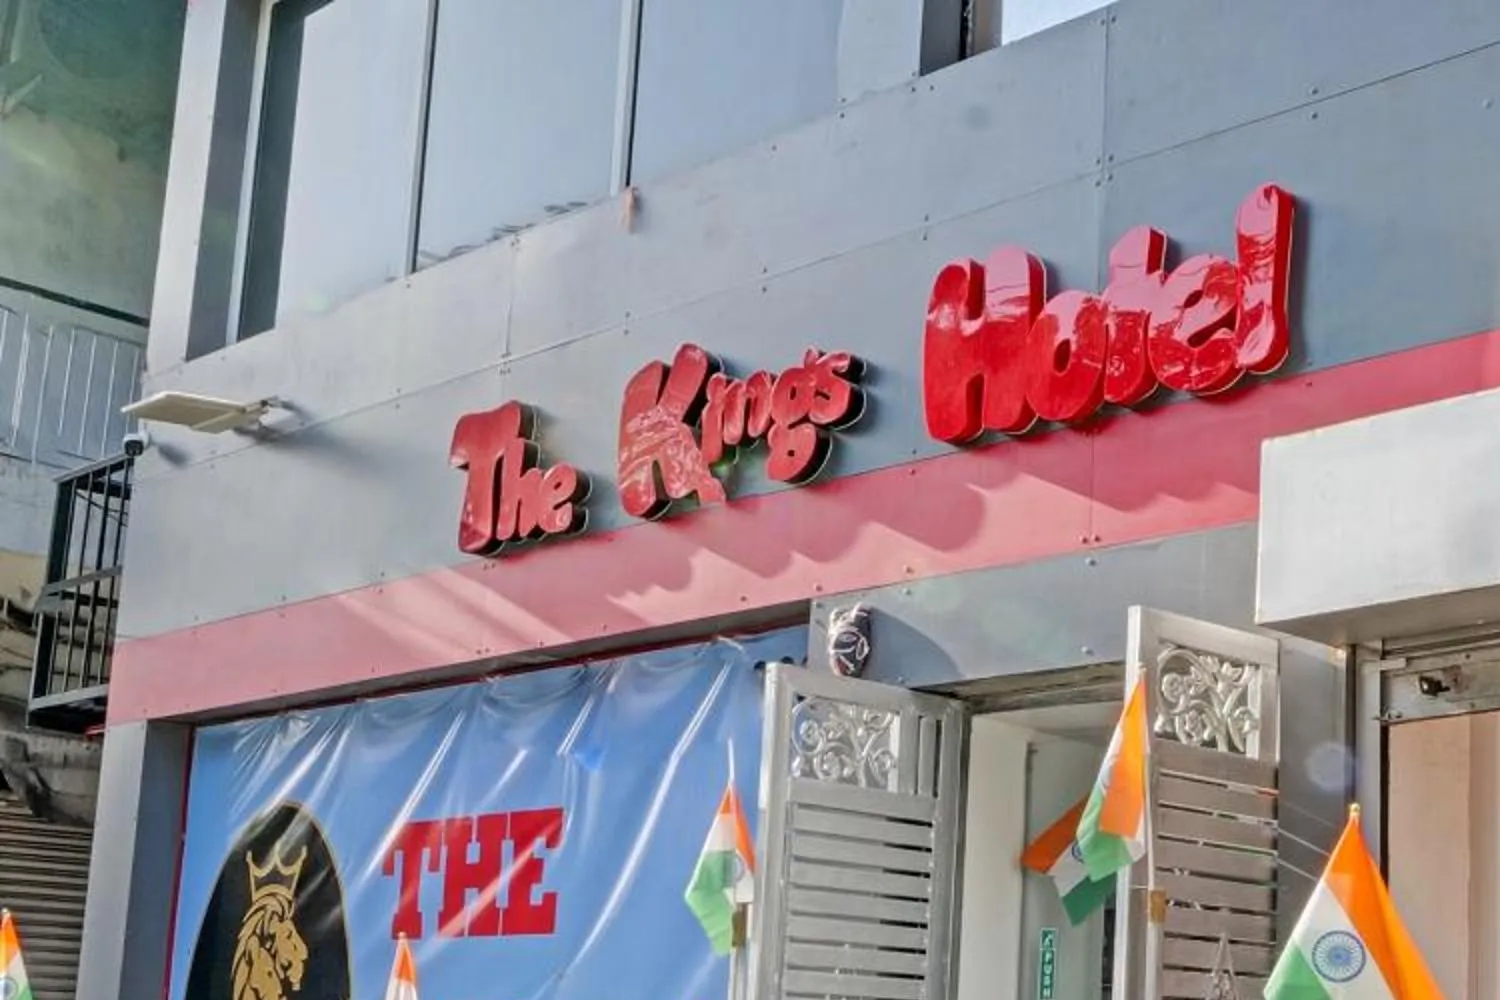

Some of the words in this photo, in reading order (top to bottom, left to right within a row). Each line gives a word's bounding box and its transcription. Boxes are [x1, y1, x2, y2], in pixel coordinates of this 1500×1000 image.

[449, 400, 592, 556] The
[922, 182, 1297, 444] Hotel
[382, 807, 563, 940] THE
